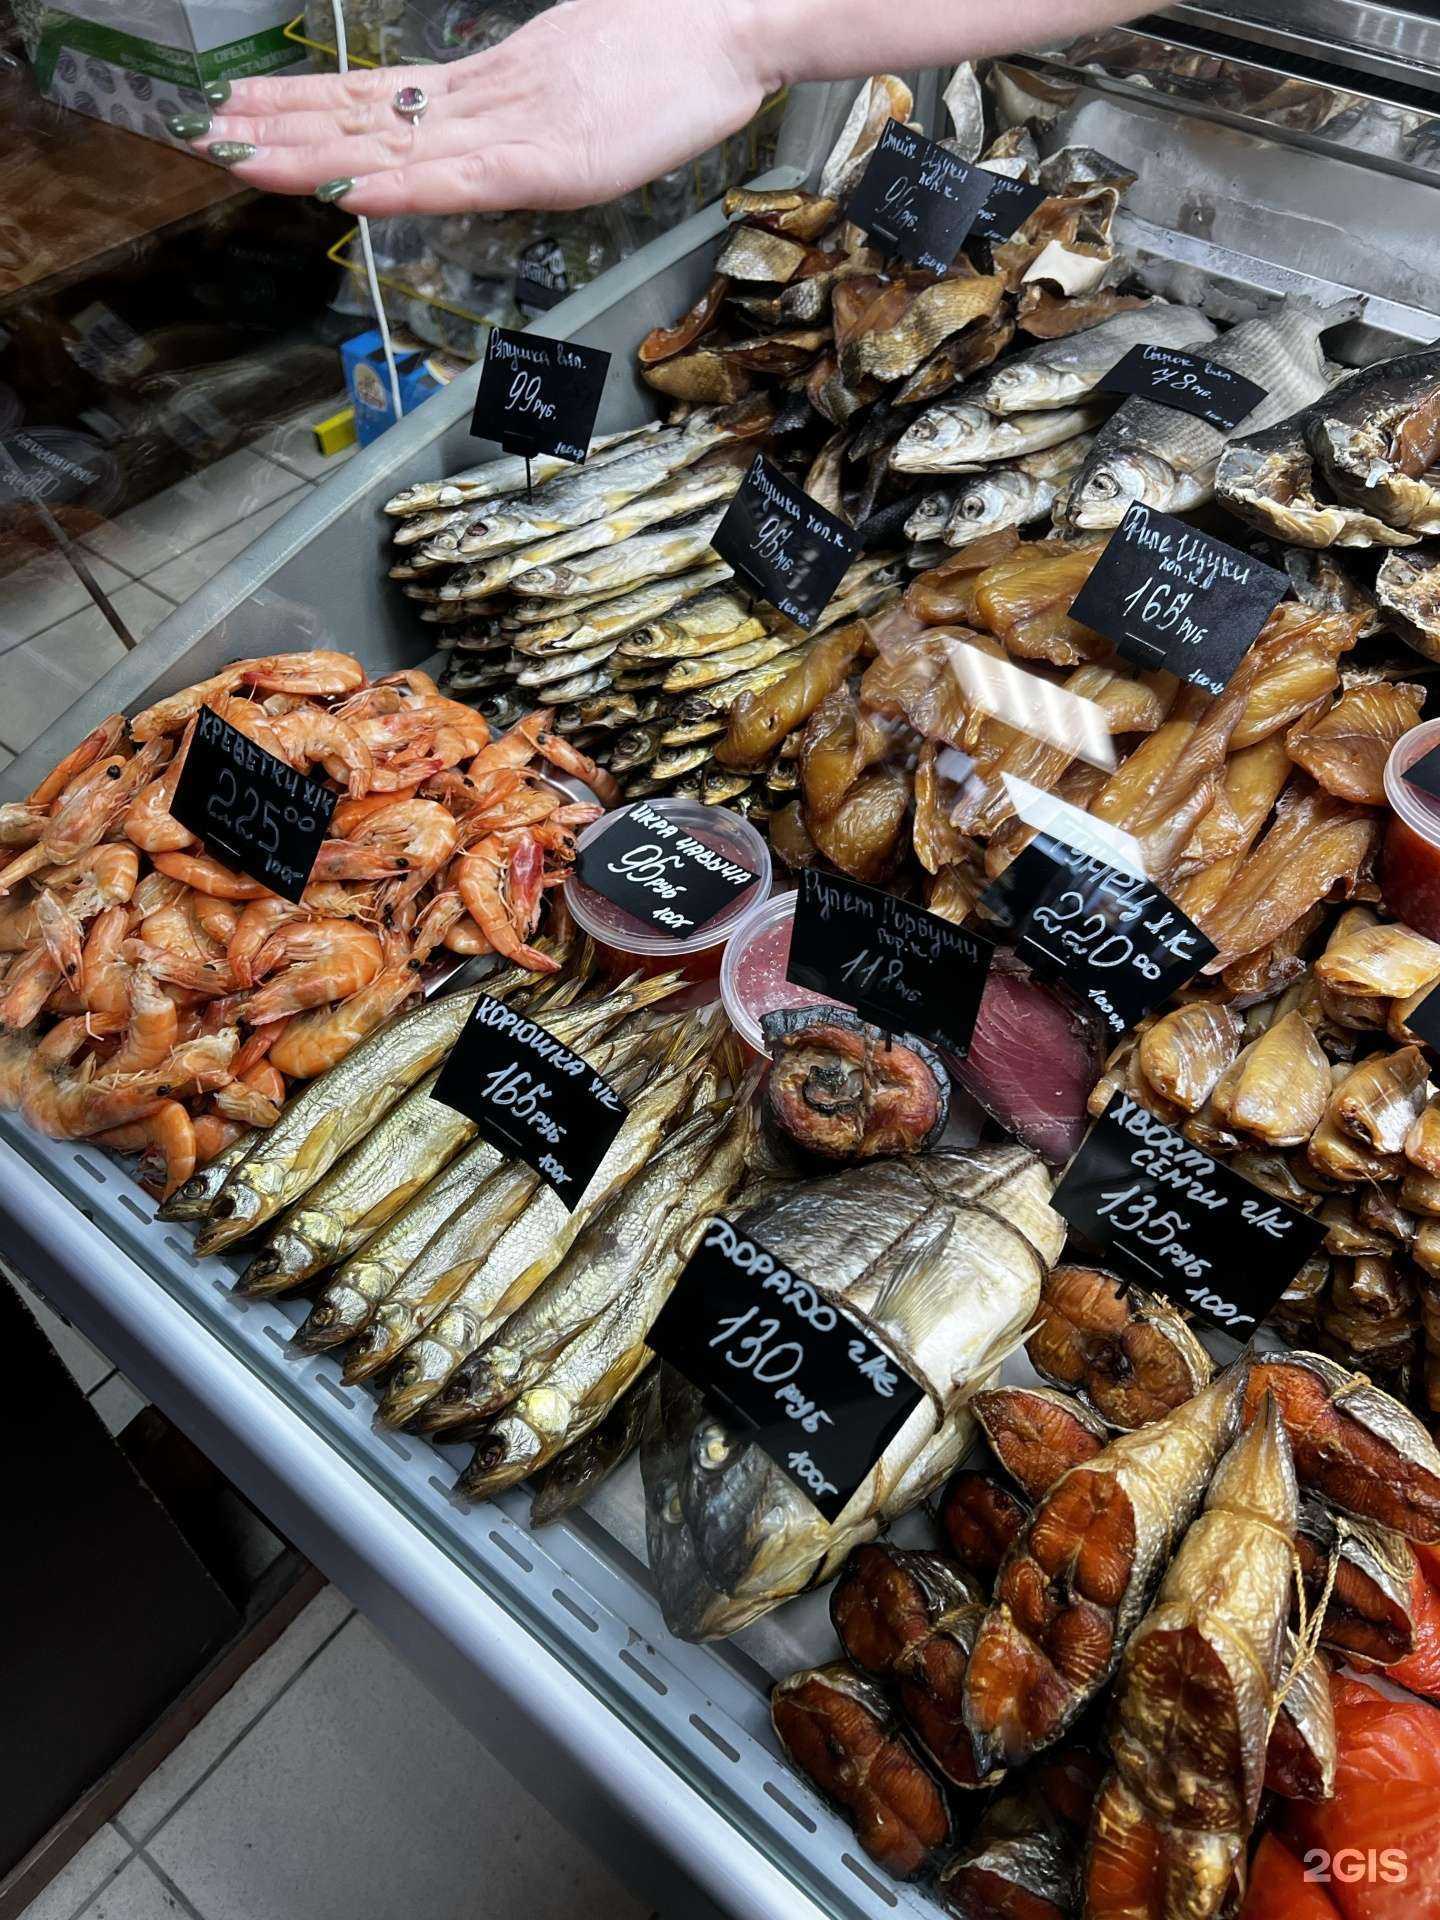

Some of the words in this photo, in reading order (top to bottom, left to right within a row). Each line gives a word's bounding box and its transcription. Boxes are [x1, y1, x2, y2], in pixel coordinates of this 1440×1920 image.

[629, 803, 679, 839] ИКРА
[476, 997, 586, 1076] КОРЮШКА
[705, 1217, 837, 1332] ДОРАДО
